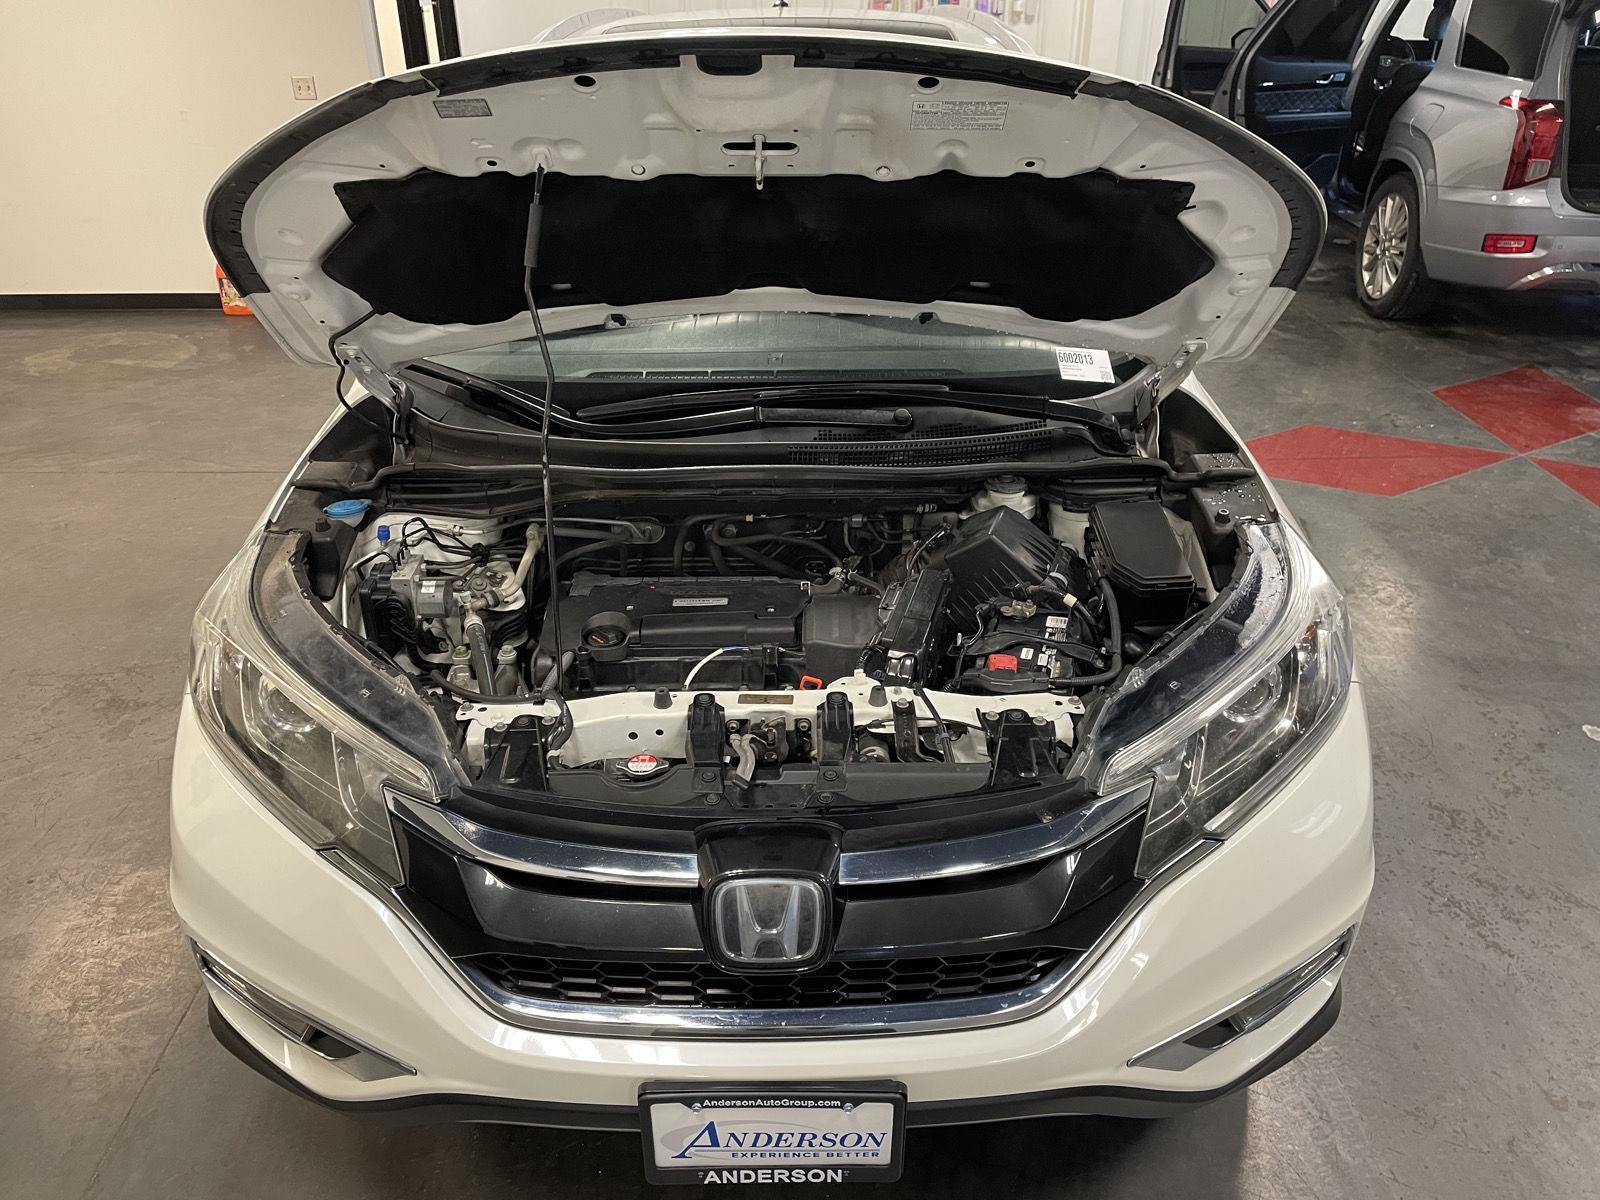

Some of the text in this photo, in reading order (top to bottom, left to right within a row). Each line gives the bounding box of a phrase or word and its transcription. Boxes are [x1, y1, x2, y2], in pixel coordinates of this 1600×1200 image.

[1057, 351, 1094, 365] 6002013
[702, 1098, 841, 1109] AndersonAutoGroup.com
[671, 1120, 888, 1159] ANDERSON
[731, 1151, 820, 1159] EXPERIENCE
[703, 1168, 843, 1185] ANDERSON
